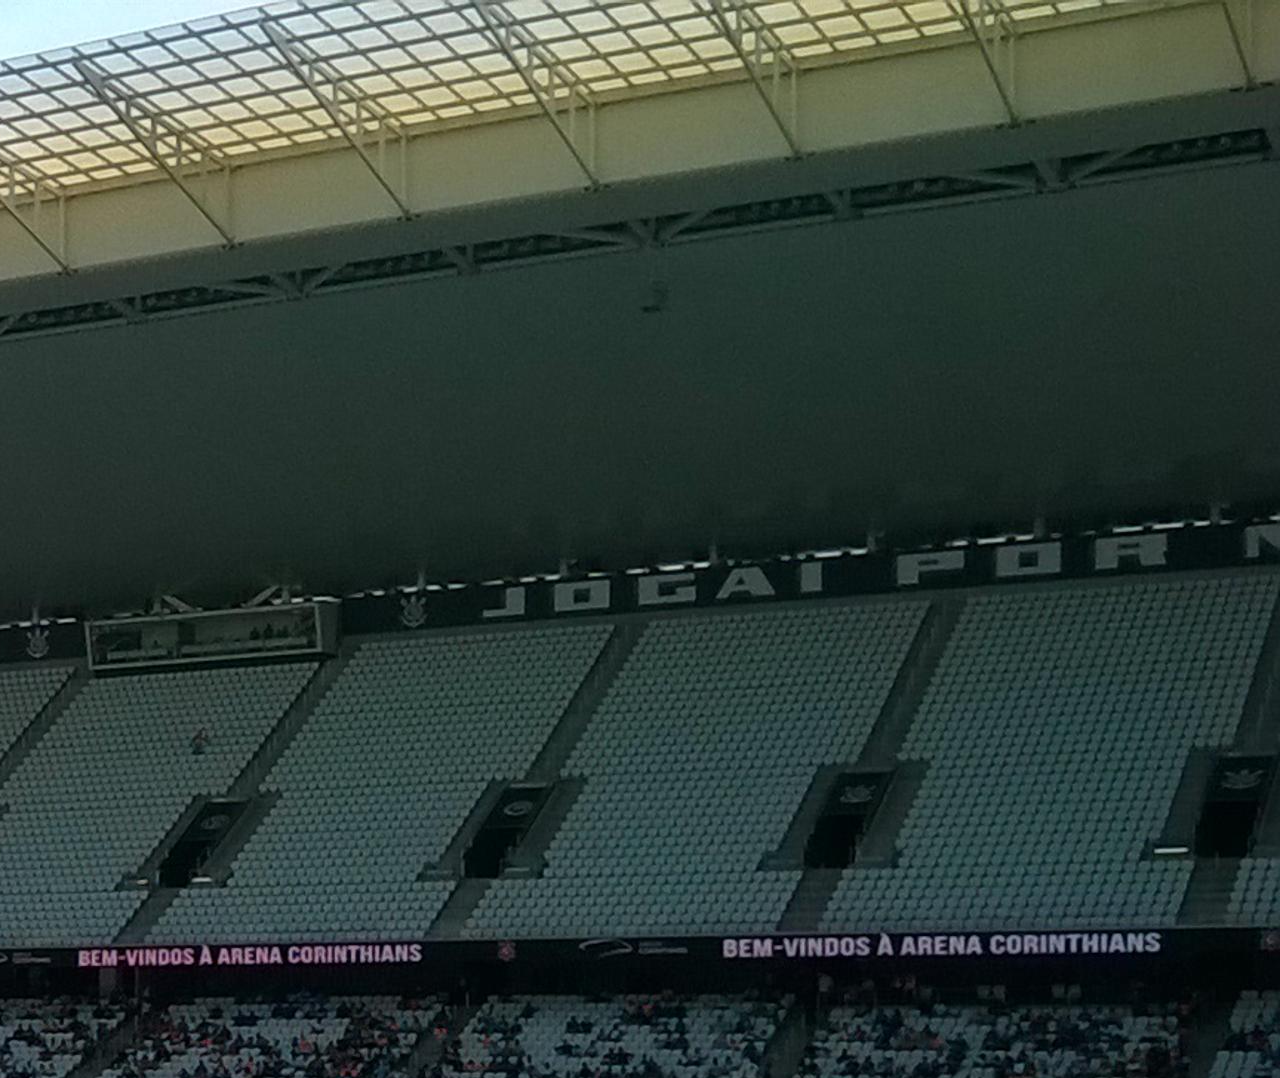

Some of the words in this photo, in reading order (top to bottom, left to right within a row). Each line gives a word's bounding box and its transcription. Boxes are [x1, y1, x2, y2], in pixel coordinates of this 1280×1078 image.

[482, 561, 823, 618] JOGAI
[896, 533, 1168, 586] POR
[78, 948, 195, 967] BEM-VINDOS
[199, 943, 213, 965] À
[217, 947, 283, 965] ARENA
[288, 944, 422, 964] CORINTHIANS
[723, 937, 870, 958] BEM-VINDOS
[877, 932, 894, 956] À
[900, 935, 983, 956] ARENA
[989, 932, 1161, 955] CORINTHIANS
